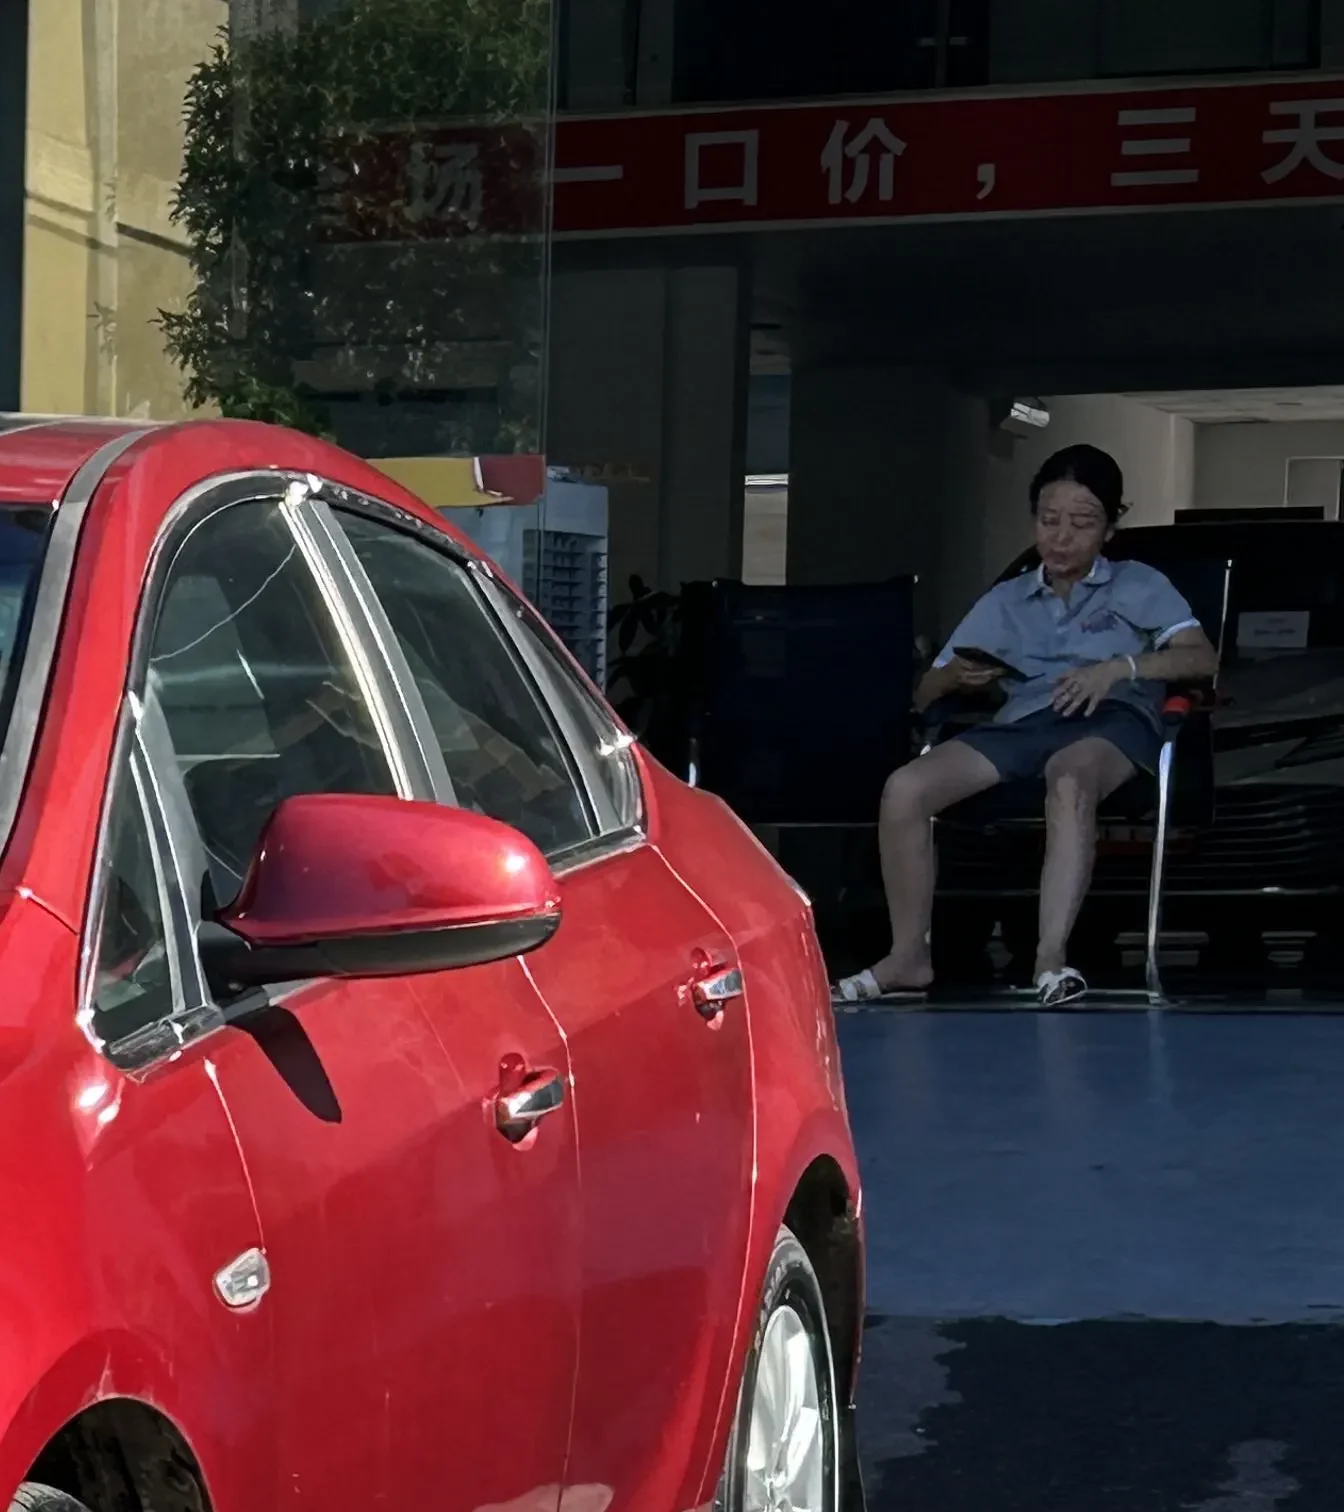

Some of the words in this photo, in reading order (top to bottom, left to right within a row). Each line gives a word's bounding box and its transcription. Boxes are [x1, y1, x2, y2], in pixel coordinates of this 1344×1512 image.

[317, 99, 1344, 224] 场一口价，三天
